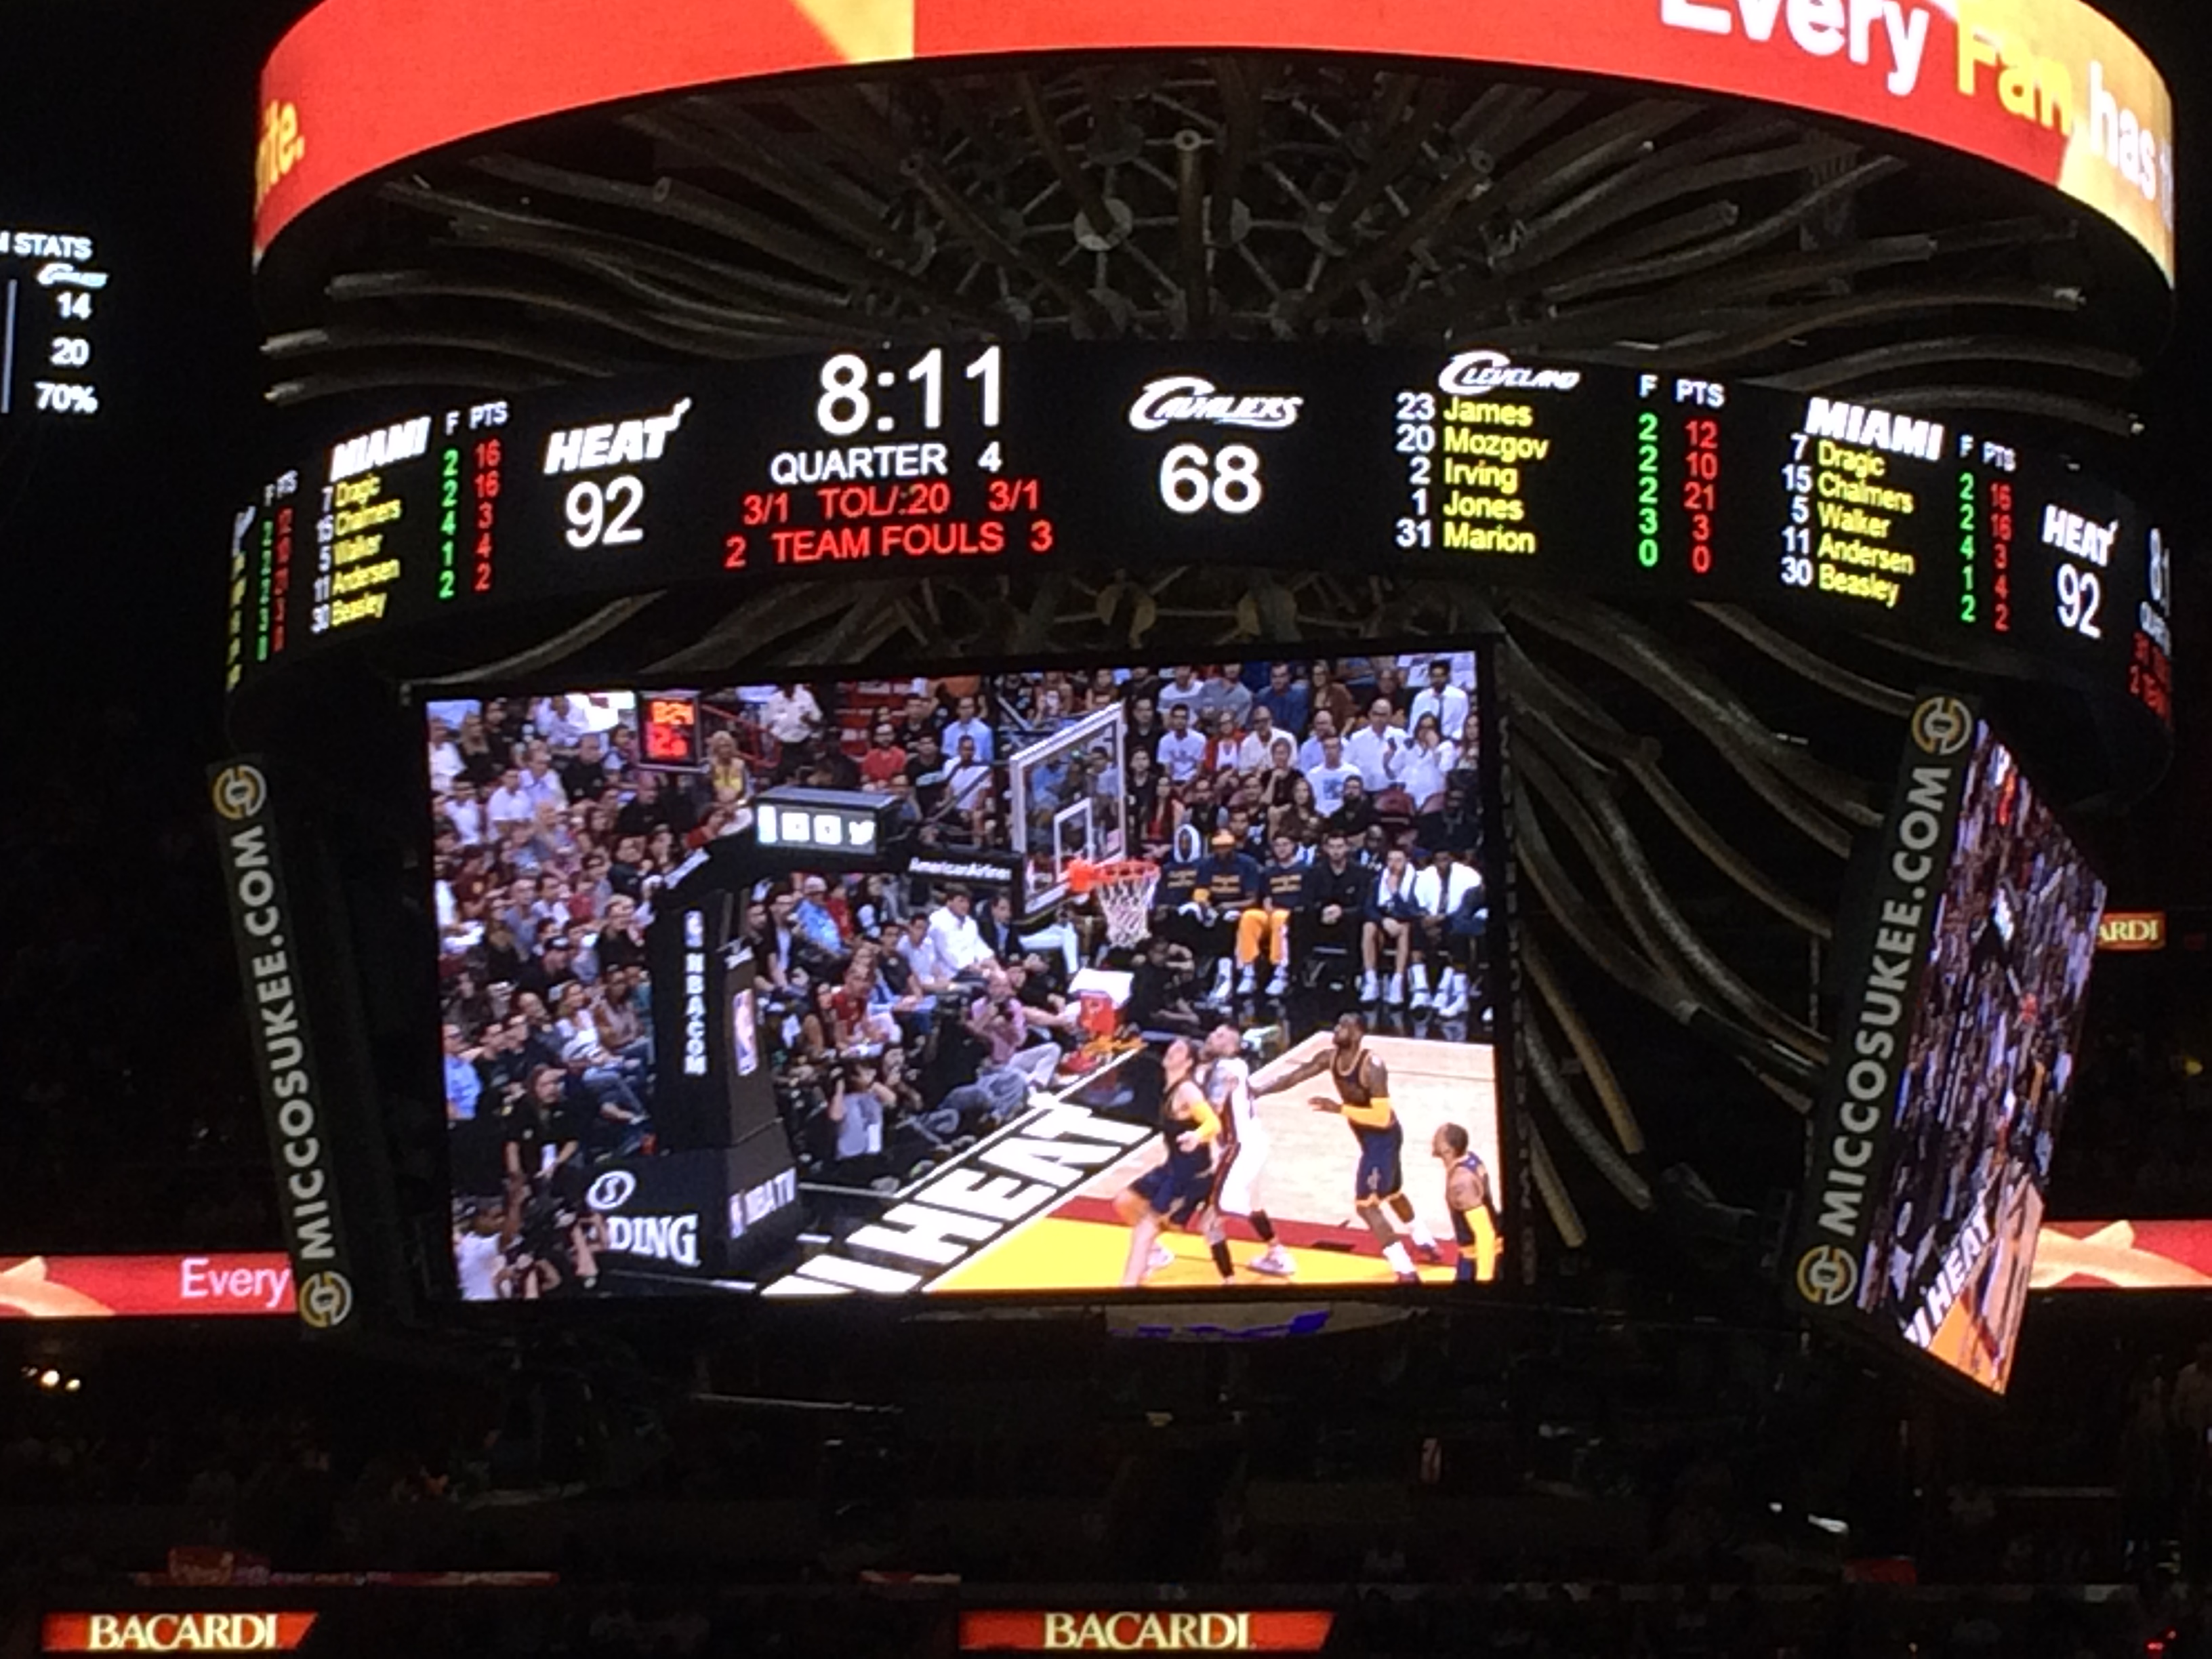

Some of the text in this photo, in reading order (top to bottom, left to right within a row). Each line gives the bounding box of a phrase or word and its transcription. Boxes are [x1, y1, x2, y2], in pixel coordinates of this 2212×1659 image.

[1957, 17, 2072, 136] Fan
[2090, 60, 2156, 200] has
[14, 232, 93, 260] STATS
[56, 291, 92, 319] 14
[49, 337, 90, 367] 20
[35, 382, 99, 413] 70%
[817, 345, 1001, 436] 8:11
[1639, 374, 1725, 408] F PTS
[445, 409, 461, 436] F
[469, 401, 508, 430] PTS
[543, 396, 692, 475] HEAT
[1395, 391, 1719, 449] 23 James 2 12
[1803, 396, 2017, 472] MIAMI F PTS
[443, 449, 458, 477] 2
[475, 438, 501, 469] 16
[771, 441, 1003, 486] QUARTER 4
[1395, 423, 1719, 480] 20 Mozgov 2 10
[1790, 433, 1809, 461] 7
[1818, 440, 1886, 478] Dragic
[1960, 473, 1974, 500] 2
[443, 479, 457, 507] 2
[474, 470, 500, 499] 16
[743, 491, 789, 525] 3/1
[988, 479, 1039, 512] 3/1
[1160, 444, 1263, 514] 68
[1410, 455, 1715, 510] 2 Irving 2 21
[1781, 464, 1813, 494] 15
[1818, 472, 1914, 514] Chalmers
[1960, 504, 1974, 531] 2
[441, 510, 456, 535] 4
[477, 501, 493, 529] 3
[565, 474, 644, 548] 92
[1412, 488, 1711, 542] 1 Jones 3 3
[1790, 495, 1810, 525] 5
[1818, 502, 1891, 537] Walker
[1960, 534, 1975, 560] 4
[2041, 503, 2120, 567] HEAT
[443, 541, 453, 566] 1
[475, 533, 492, 559] 4
[724, 520, 1053, 569] 2 TEAM FOULS 3
[1395, 518, 1711, 573] 31 Marion 0 0
[1781, 526, 2009, 600] 11 Andersen 1 4
[439, 571, 455, 598] 2
[474, 562, 491, 592] 2
[1780, 556, 2009, 631] 30 Beasley 2 2
[2057, 562, 2102, 639] 92
[2099, 919, 2159, 941] ARDI
[1818, 764, 1952, 1237] MICCOSUKEE.COM
[229, 824, 335, 1261] MICCOSUKEE.COM
[607, 1213, 699, 1267] DING
[179, 1256, 293, 1309] Every
[87, 1613, 278, 1652] BACARDI
[1044, 1613, 1251, 1651] BACARDI
